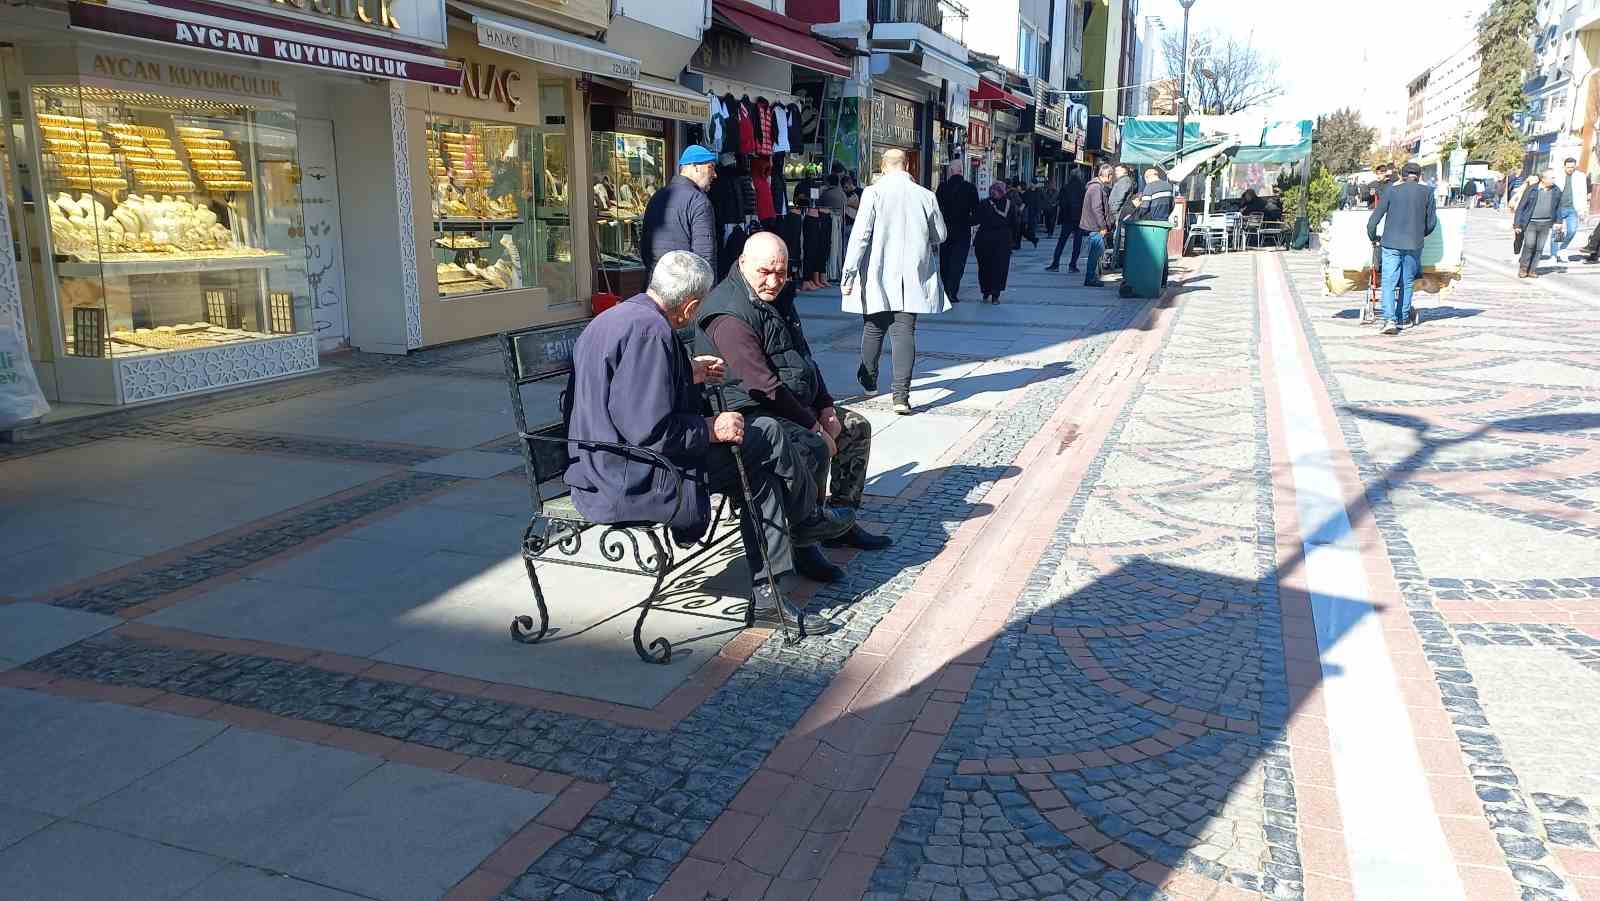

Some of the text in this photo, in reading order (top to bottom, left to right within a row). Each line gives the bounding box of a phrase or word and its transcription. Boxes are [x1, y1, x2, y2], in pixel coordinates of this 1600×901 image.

[95, 53, 283, 97] AYCAN KUYUMCULUK
[175, 22, 408, 78] AYCAN KUYUMCULUK
[434, 58, 521, 112] ALAÇ
